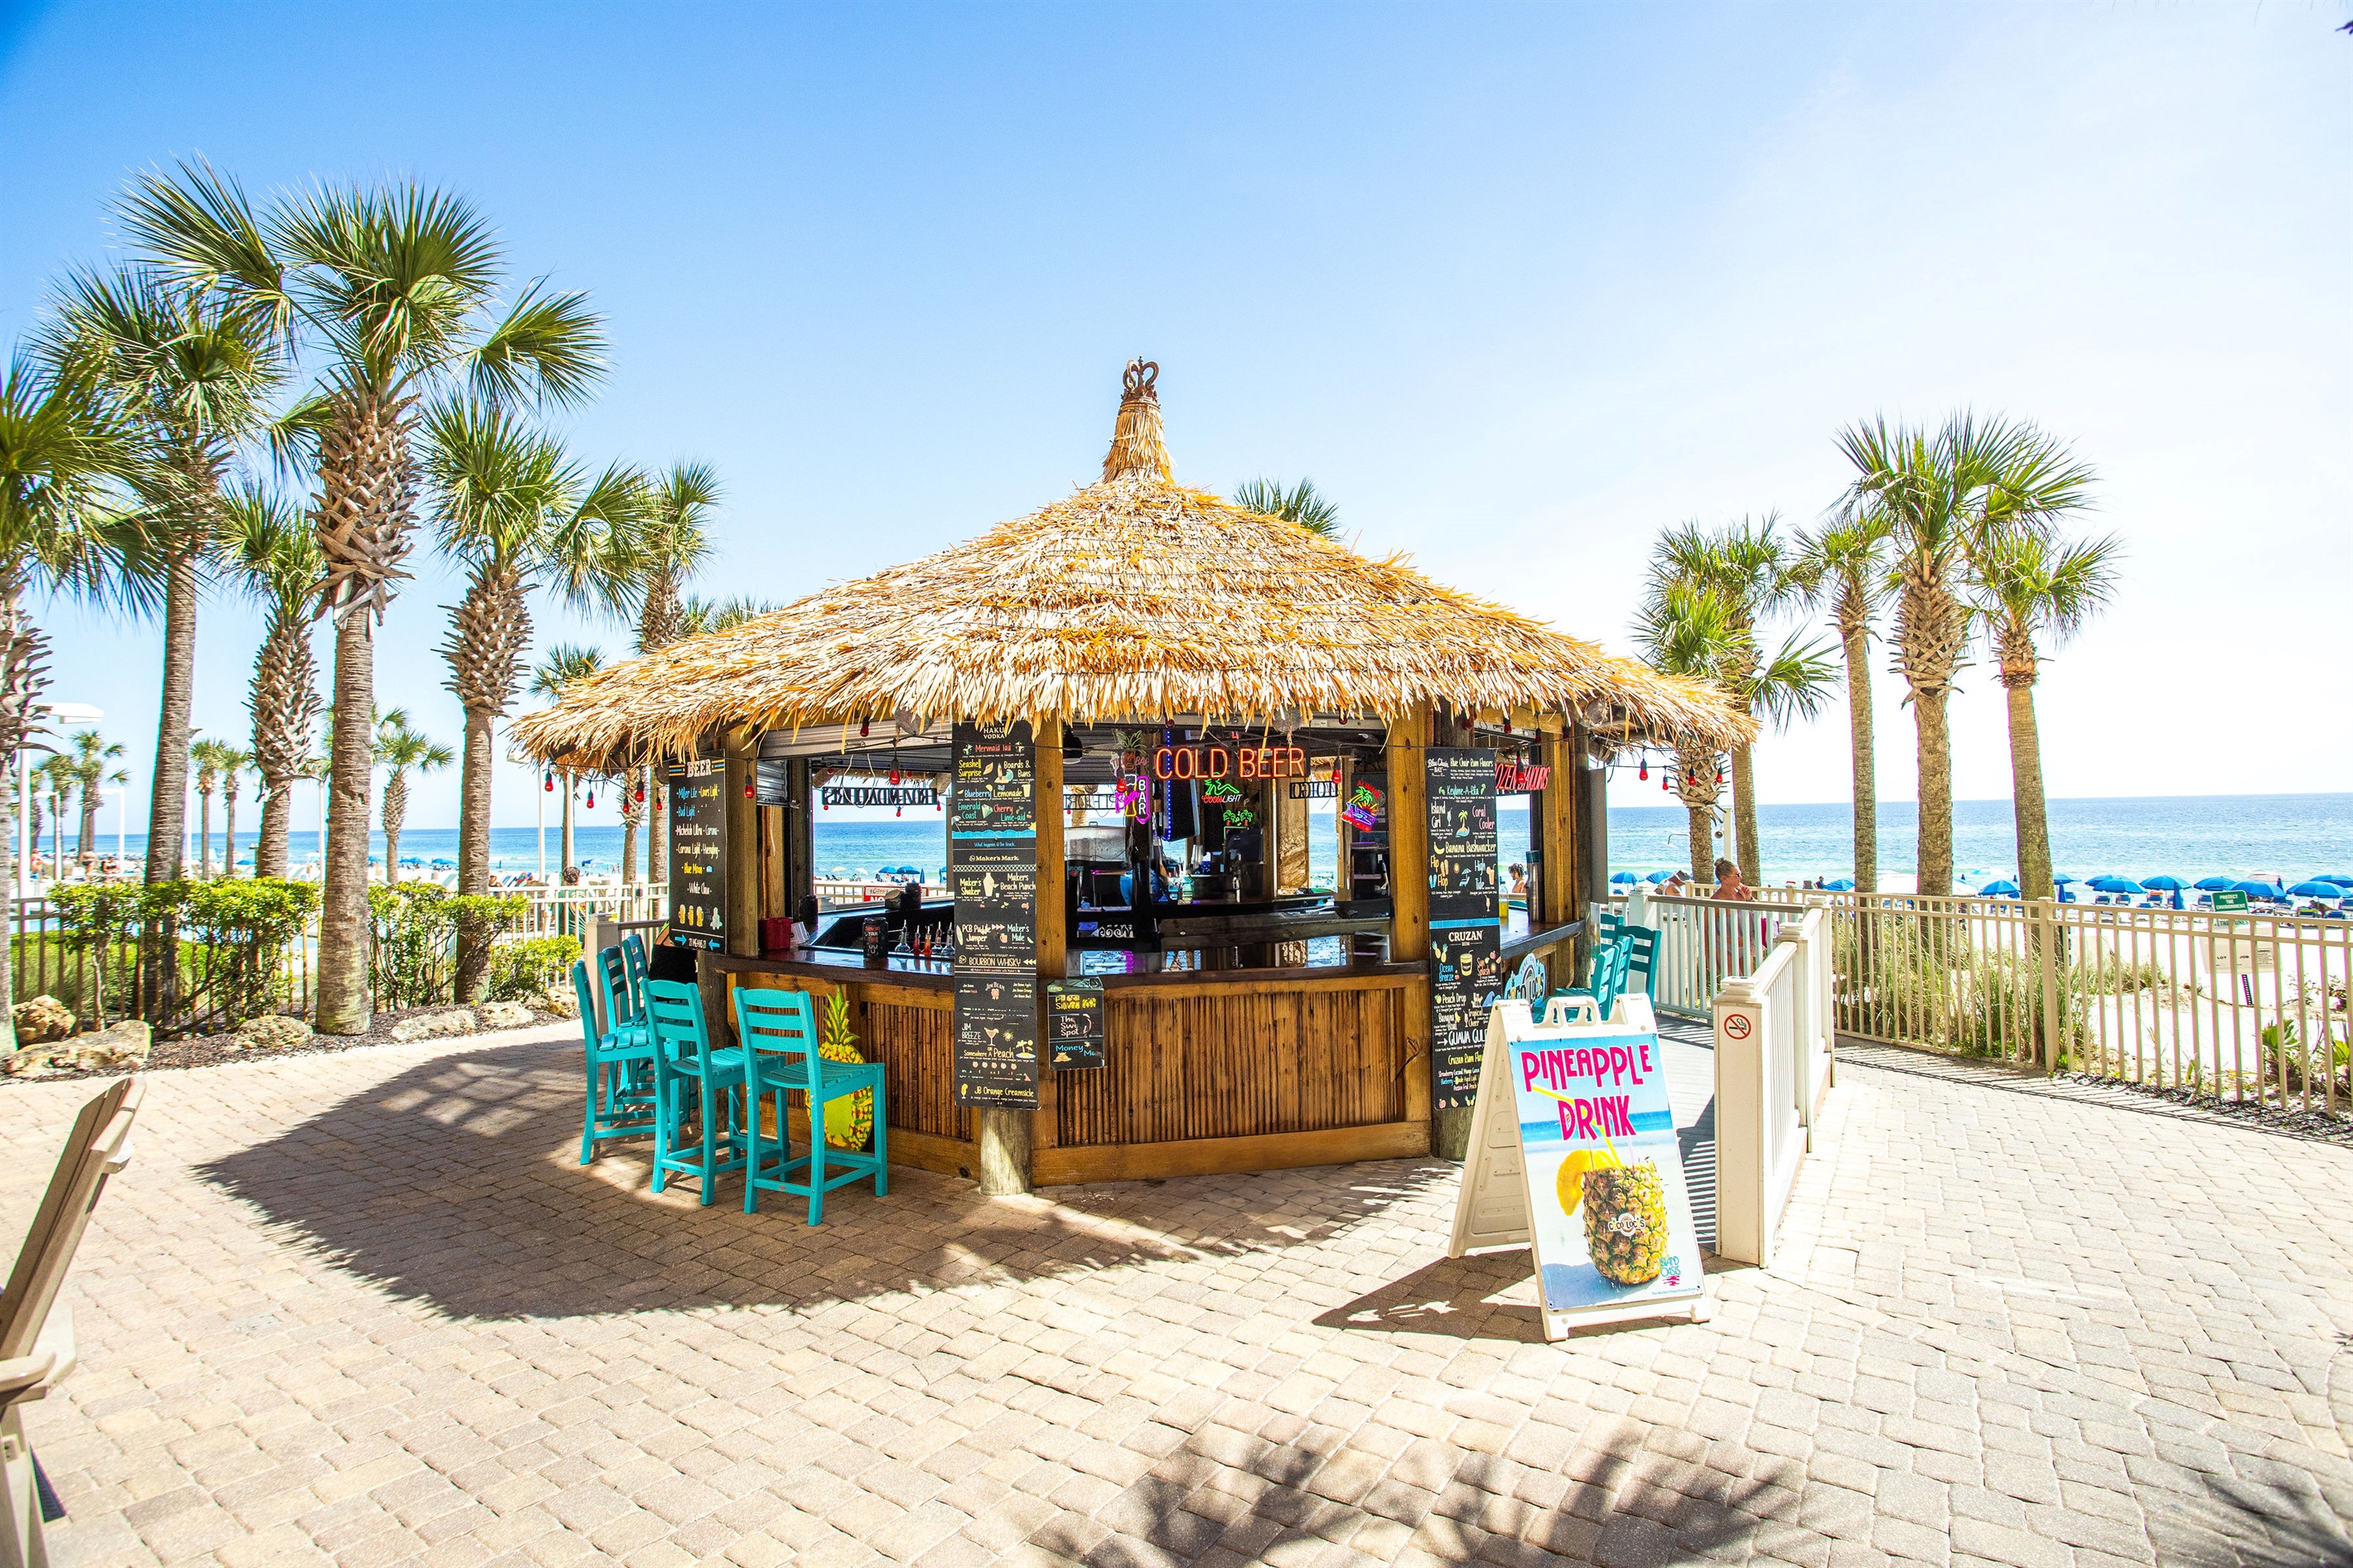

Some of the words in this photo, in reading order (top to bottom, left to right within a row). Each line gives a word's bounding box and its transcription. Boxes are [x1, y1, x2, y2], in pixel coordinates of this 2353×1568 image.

[975, 744, 1000, 752] Mermaid
[959, 759, 981, 769] Seashell
[1004, 760, 1023, 769] Boards
[1156, 747, 1229, 779] COLD
[1239, 747, 1306, 779] BEER
[1450, 757, 1458, 767] Blue
[1459, 757, 1469, 767] Chair
[1471, 758, 1479, 767] Rum
[1480, 757, 1493, 767] Flavors
[687, 759, 712, 778] BEER
[959, 769, 982, 779] Surprise
[964, 789, 992, 799] Blueberry
[993, 788, 1022, 798] Lemonade
[1222, 794, 1243, 803] LIGHT
[958, 801, 981, 810] Emerald
[993, 803, 1013, 815] Cherry
[1431, 800, 1446, 814] Island
[1472, 804, 1486, 817] Coral
[1001, 812, 1026, 821] Lime-aid
[1432, 814, 1442, 828] Girl
[1479, 817, 1495, 830] Cooler
[1445, 841, 1465, 853] Banana
[1466, 839, 1496, 853] Bushwacker
[684, 861, 692, 874] Blue
[693, 863, 703, 875] Moon
[1430, 854, 1439, 872] Flip
[1475, 857, 1486, 876] High
[1007, 872, 1029, 881] Makers
[1437, 873, 1448, 891] Flop
[1475, 876, 1485, 890] Tide
[689, 880, 700, 894] White
[959, 877, 982, 886] Maker's
[1000, 881, 1017, 890] Beach
[1019, 881, 1036, 890] Punch
[961, 886, 981, 895] Shaker
[962, 924, 973, 933] PCB
[974, 924, 991, 935] Puddle
[1007, 923, 1029, 933] Maker's
[966, 934, 988, 944] Jumper
[1012, 933, 1025, 941] Mule
[1448, 930, 1483, 942] CRUZAN
[969, 958, 995, 966] BOURBON
[997, 958, 1021, 967] WHISKY
[1439, 963, 1454, 972] Ocean
[1438, 972, 1454, 982] Breeze
[1442, 992, 1456, 1004] Peach
[1457, 993, 1466, 1006] Drop
[1438, 1012, 1454, 1023] Banana
[1468, 1018, 1479, 1027] Cheer
[1447, 1021, 1457, 1030] Boat
[961, 1031, 981, 1040] BREEZE
[1061, 1029, 1079, 1038] Spot
[1448, 1030, 1471, 1045] GUAVA
[993, 1047, 1014, 1059] Peach
[1056, 1045, 1083, 1053] Money
[1448, 1054, 1463, 1065] Cruzan
[1465, 1053, 1474, 1064] Rum
[1520, 1045, 1653, 1092] PINEAPPLE
[974, 1086, 982, 1094] JB
[983, 1086, 1003, 1098] Orange
[1005, 1088, 1034, 1097] Creamsicle
[1558, 1095, 1636, 1141] DRINK
[1660, 1256, 1679, 1267] ISLAND
[1660, 1266, 1681, 1276] OASIS
